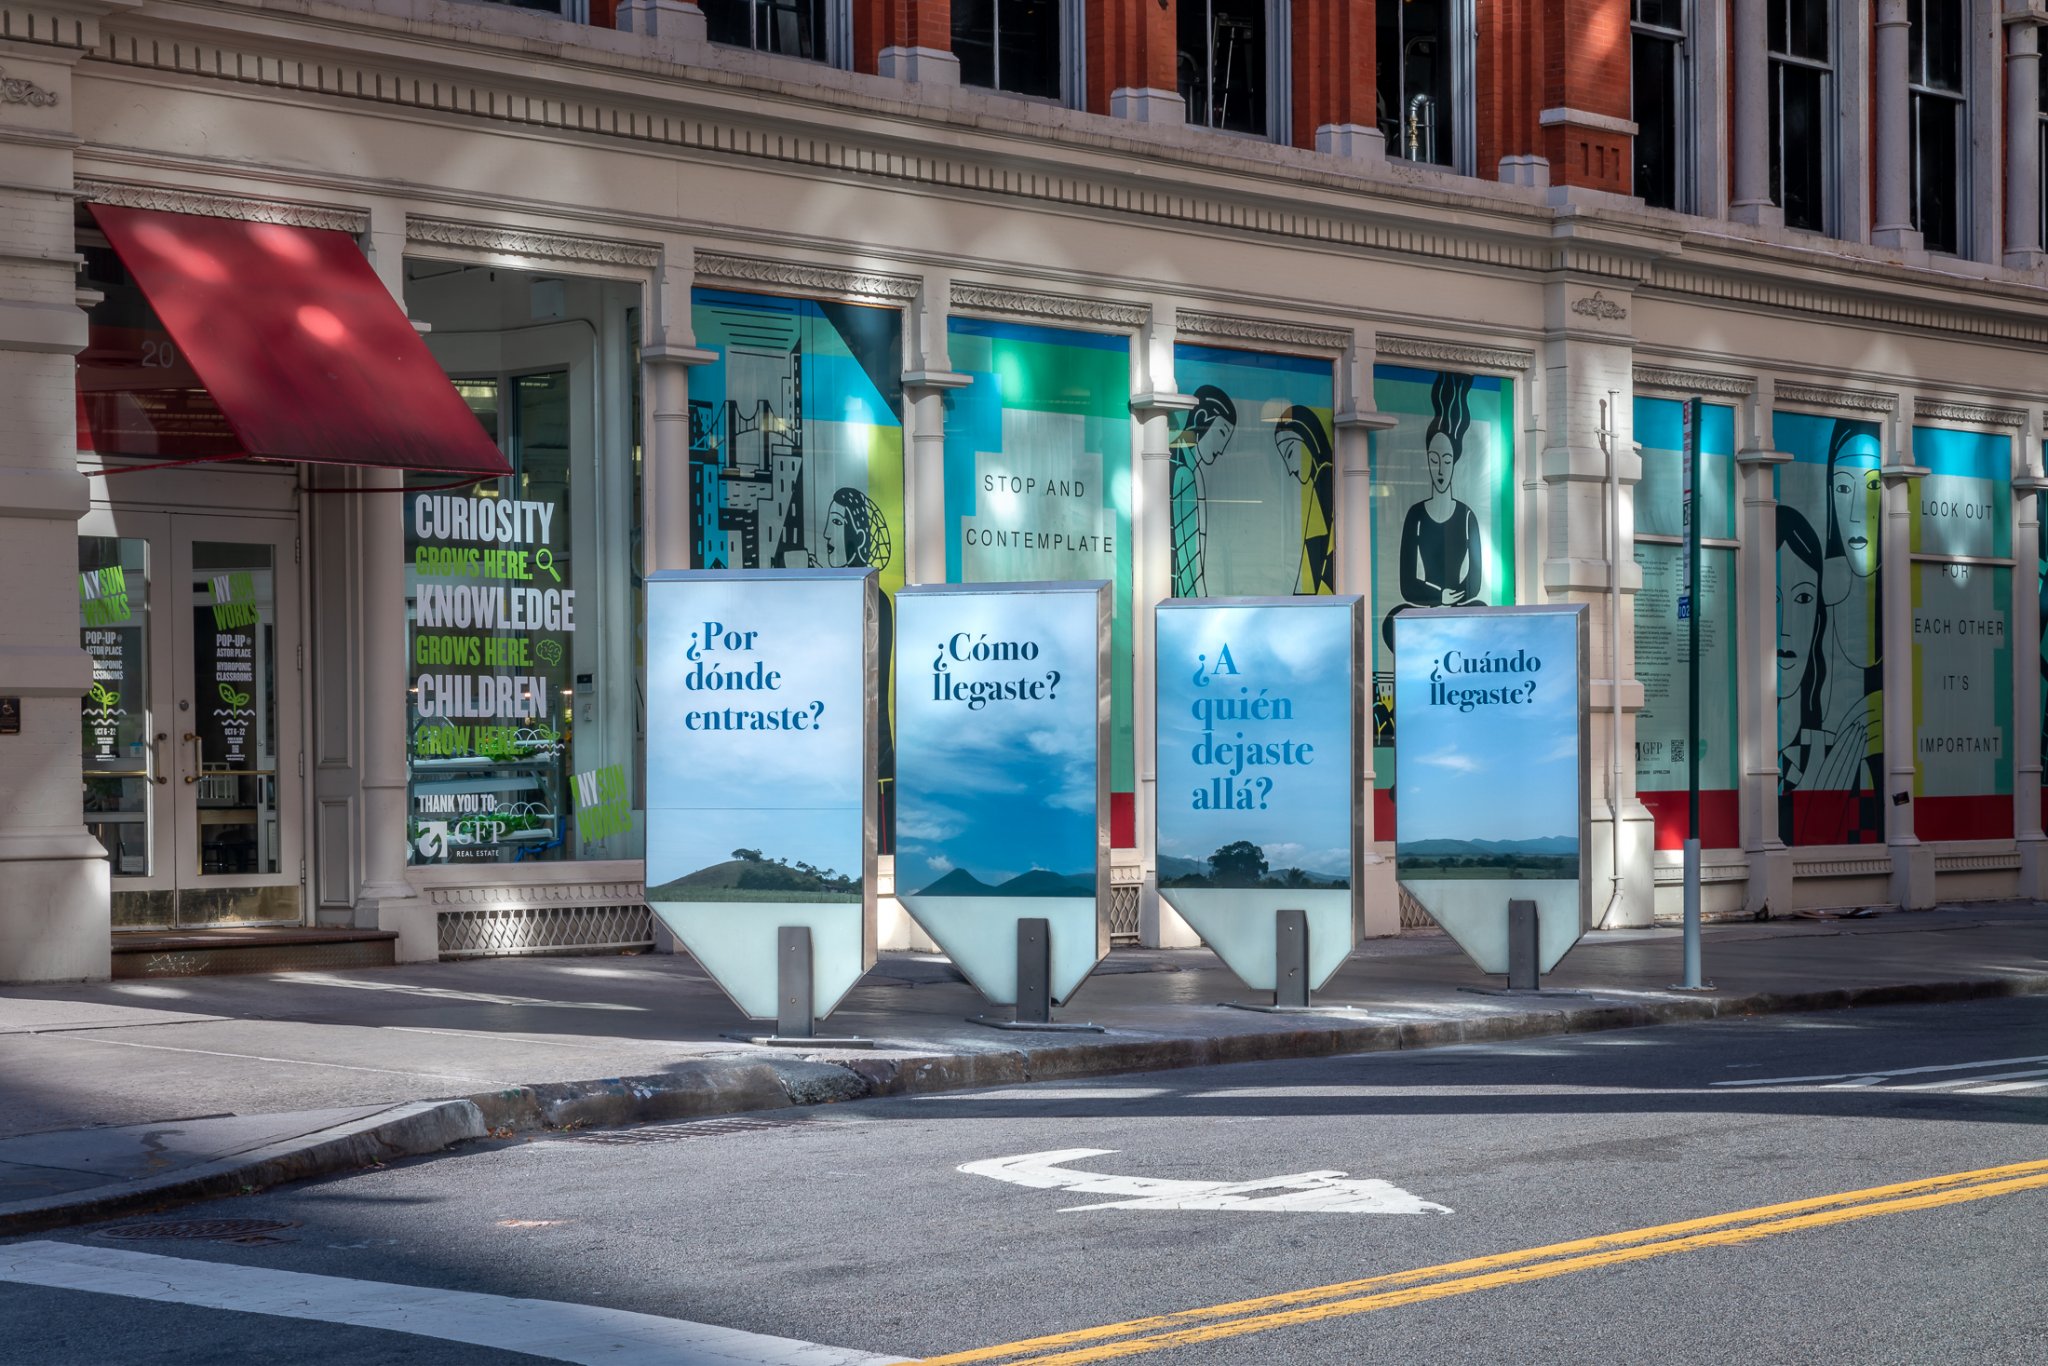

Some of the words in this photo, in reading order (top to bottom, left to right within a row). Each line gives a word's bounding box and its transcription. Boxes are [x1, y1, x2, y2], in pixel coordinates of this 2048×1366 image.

[141, 340, 174, 368] 20
[984, 475, 1035, 494] STOP
[1046, 479, 1085, 498] AND
[415, 494, 555, 544] CURIOSITY
[1921, 500, 1959, 518] LOOK
[1965, 503, 1993, 520] OUT
[966, 528, 1112, 553] CONTEMPLATE
[415, 546, 480, 577] GROWS
[484, 549, 534, 580] HERE.
[1941, 564, 1970, 579] FOR
[213, 600, 260, 631] WORKS
[416, 584, 576, 632] KNOWLEDGE
[85, 631, 116, 644] POP-UP
[216, 634, 245, 647] POP-UP
[686, 621, 758, 661] ¿Por
[1914, 618, 1951, 634] EACH
[1958, 620, 2004, 636] OTHER
[105, 647, 122, 655] PLACE
[216, 648, 235, 657] ASTOR
[235, 649, 251, 657] PLACE
[416, 635, 481, 666] GROWS
[484, 637, 534, 667] HERE.
[933, 632, 1039, 672] ¿Cómo
[1192, 642, 1241, 687] ¿A
[1430, 649, 1541, 682] ¿Cuándo
[216, 662, 251, 671] HYDROPONIC
[216, 672, 252, 682] CLASSROOMS
[685, 661, 781, 691] dónde
[417, 673, 547, 719] CHILDREN
[933, 670, 1061, 711] llegaste?
[1430, 680, 1537, 713] llegaste?
[1943, 675, 1969, 691] IT'S
[685, 700, 824, 731] entraste?
[1192, 687, 1293, 731] quién
[416, 724, 470, 756] GROW
[1192, 732, 1314, 776] dejaste
[1643, 741, 1662, 754] GFP
[1920, 737, 2000, 753] IMPORTANT
[419, 794, 454, 812] THANK
[457, 794, 479, 812] YOU
[482, 795, 497, 812] TO:
[1192, 777, 1273, 810] allá?
[455, 821, 505, 845] GFP
[577, 801, 633, 844] WORKS
[457, 849, 473, 857] REAL
[475, 849, 499, 857] ESTATE
